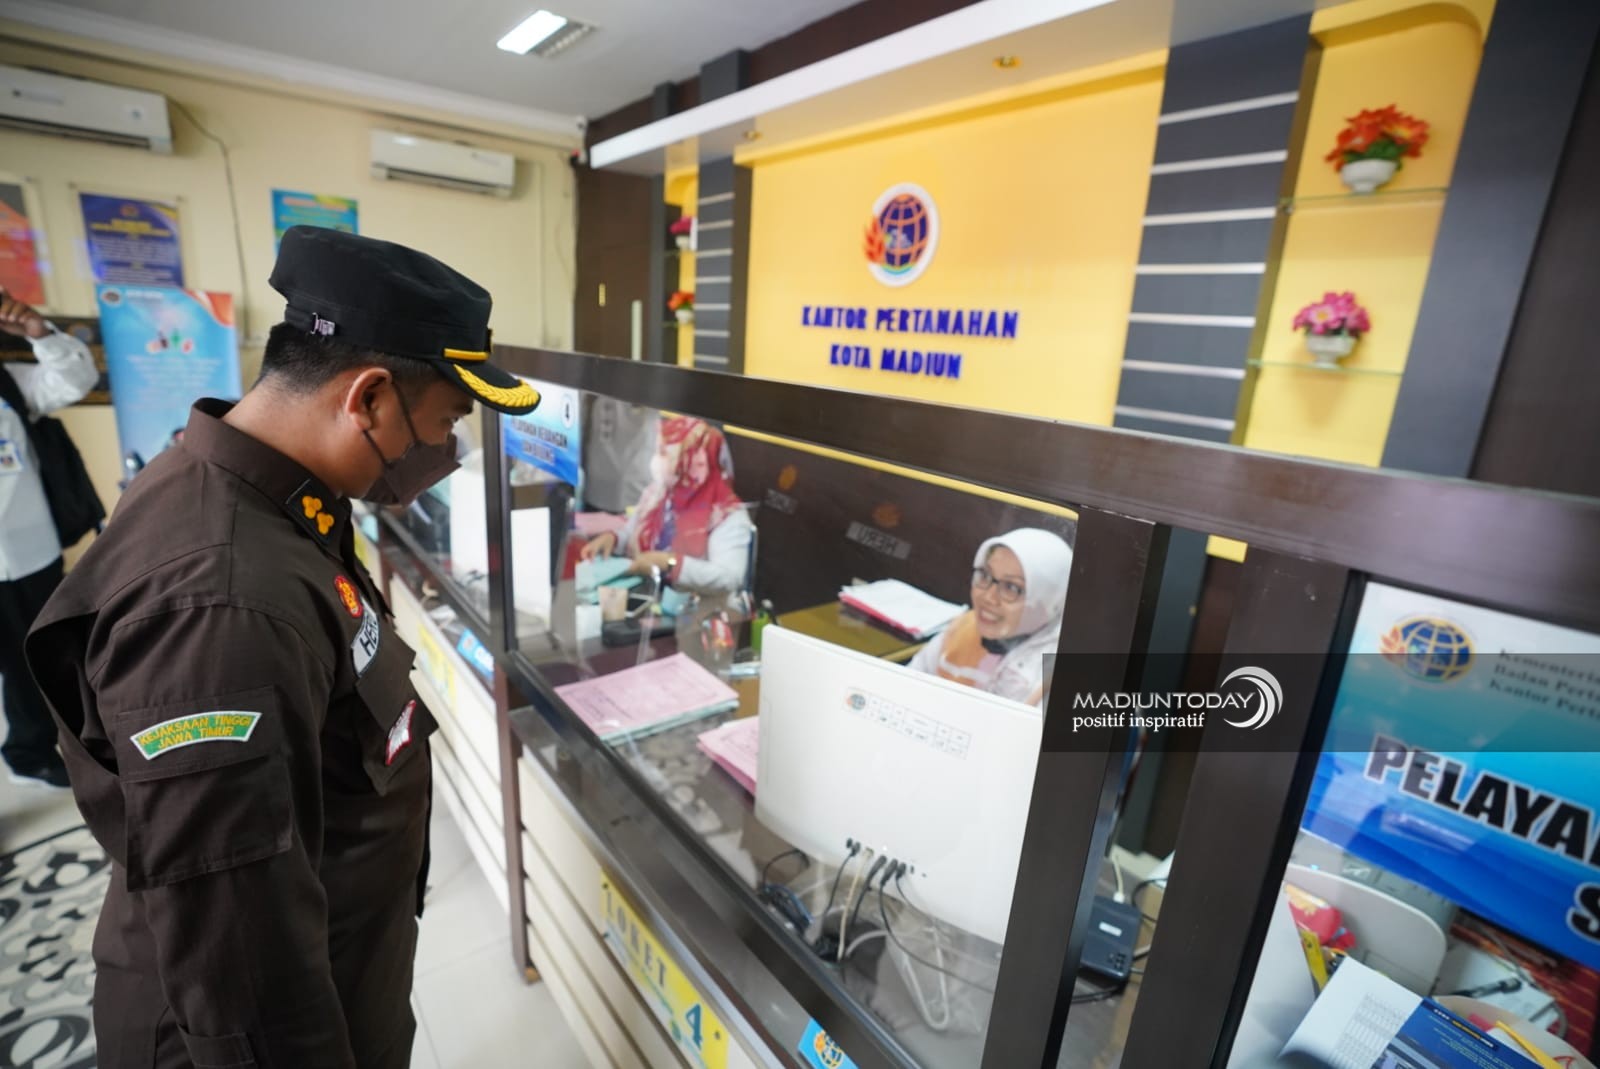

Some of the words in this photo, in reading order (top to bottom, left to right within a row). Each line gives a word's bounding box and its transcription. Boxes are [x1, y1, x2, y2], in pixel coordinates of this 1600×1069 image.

[802, 306, 868, 330] KANTOR
[876, 308, 1018, 339] PERTANAHAN
[830, 344, 871, 369] KOTA
[880, 348, 962, 379] MADIUN
[1489, 678, 1551, 704] Kantor
[1493, 663, 1550, 688] Badan
[140, 716, 209, 746] KEJAKSAAN
[213, 715, 252, 726] TINGGI
[158, 731, 193, 749] JAWA
[200, 726, 234, 738] TIMUR
[1364, 733, 1600, 871] PELAYA
[684, 1003, 703, 1050] 4
